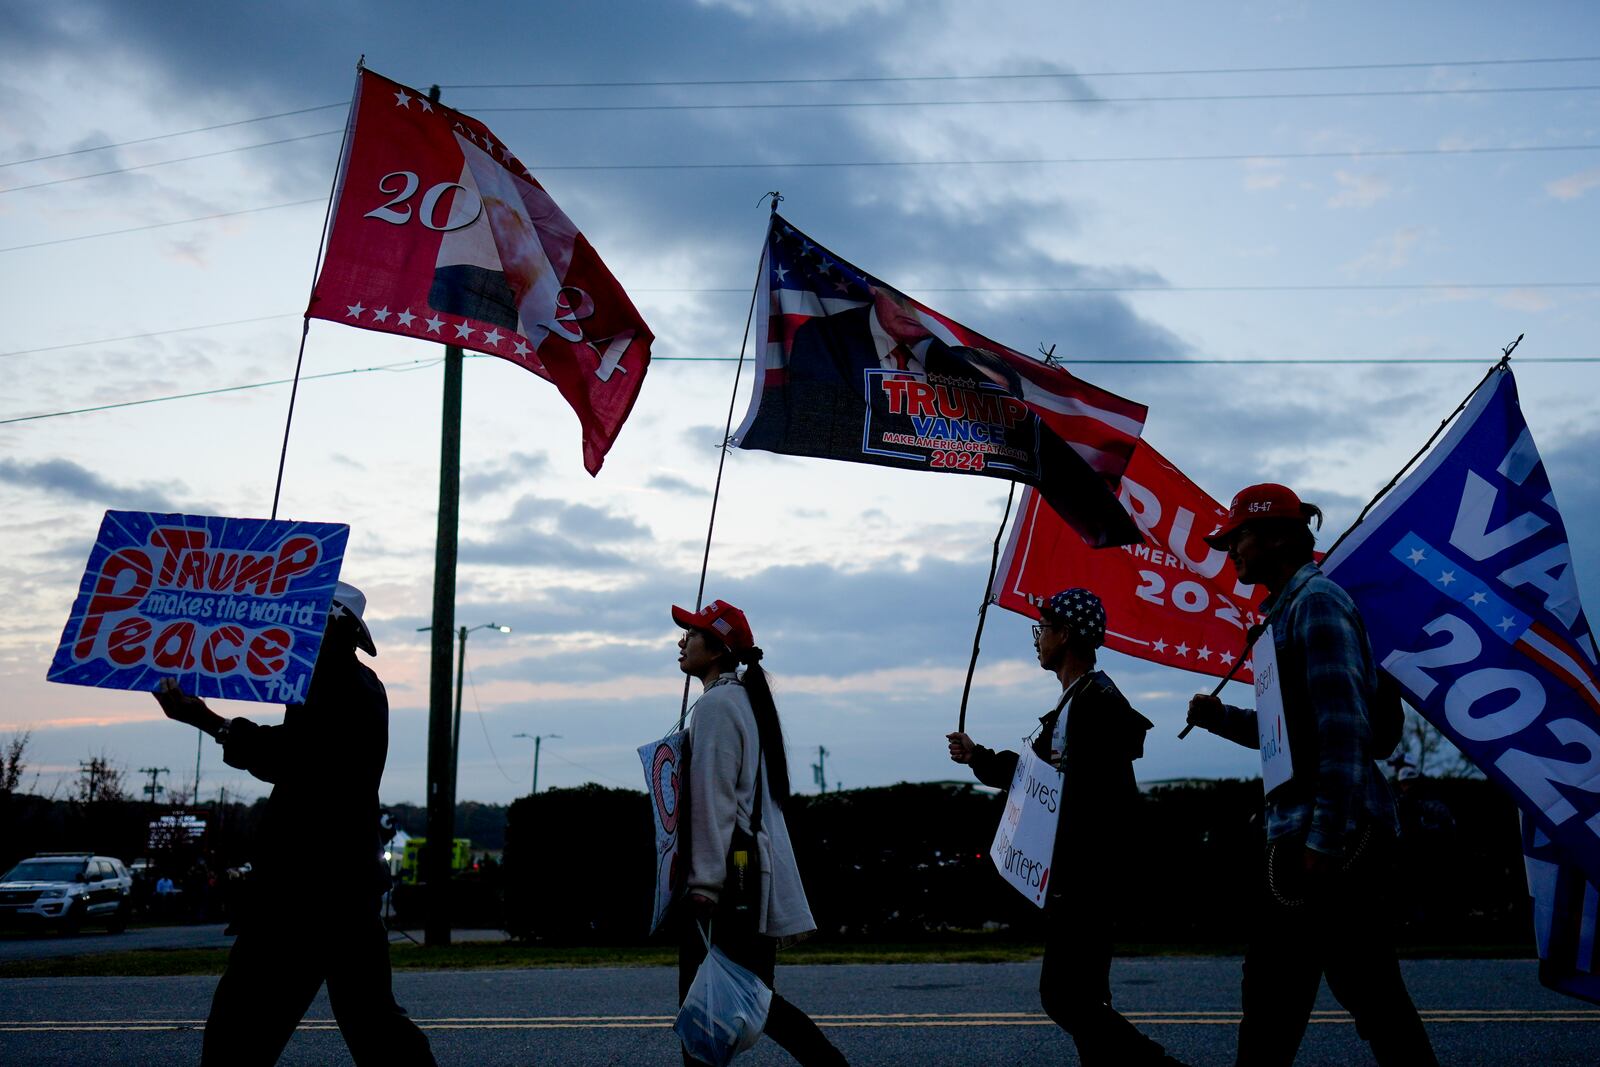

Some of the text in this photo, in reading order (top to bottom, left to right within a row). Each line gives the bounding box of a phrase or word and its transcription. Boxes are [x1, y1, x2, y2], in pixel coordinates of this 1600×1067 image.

[363, 170, 482, 232] 20
[882, 379, 1029, 429] TRUMP
[883, 432, 1029, 462] MAKE AMERICA GREAT AGAIN
[911, 416, 1006, 447] VANCE
[930, 451, 985, 471] 2024
[1248, 501, 1272, 513] 45-47
[1449, 469, 1598, 662] VA
[74, 549, 292, 677] Peace
[146, 591, 317, 626] makes the world
[1134, 570, 1244, 631] 202
[1380, 613, 1600, 838] 202
